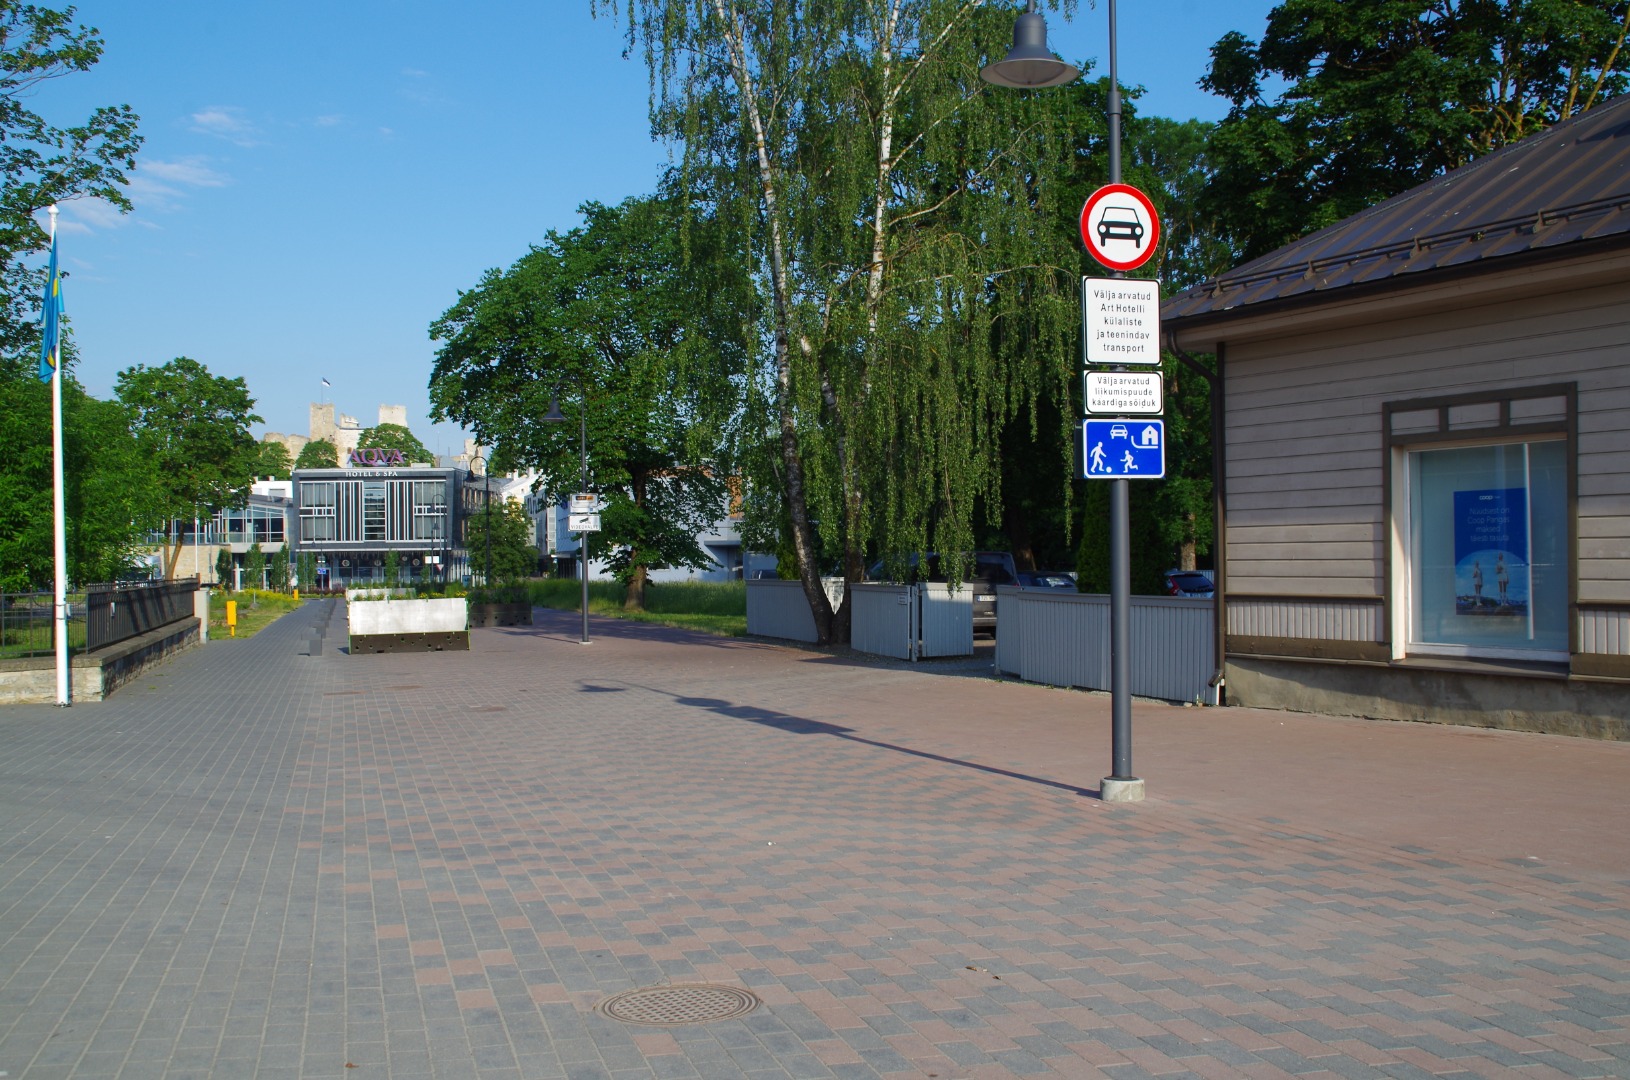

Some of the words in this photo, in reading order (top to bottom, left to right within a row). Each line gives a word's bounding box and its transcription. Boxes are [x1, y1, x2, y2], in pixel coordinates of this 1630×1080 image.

[1094, 289, 1116, 300] Välja
[1118, 292, 1151, 301] arvatud
[1100, 303, 1114, 312] Art
[1116, 304, 1145, 313] Hotelli
[1104, 316, 1142, 326] külaliste
[1096, 329, 1105, 340] ja
[1106, 330, 1150, 340] teenindav
[1103, 343, 1145, 354] transport
[1097, 376, 1118, 386] Välja
[1119, 377, 1150, 385] arvatud
[1095, 387, 1153, 397] liikumispuude
[1092, 398, 1128, 408] kaardiga
[1128, 399, 1156, 407] sõiduk
[346, 447, 405, 467] AQVA
